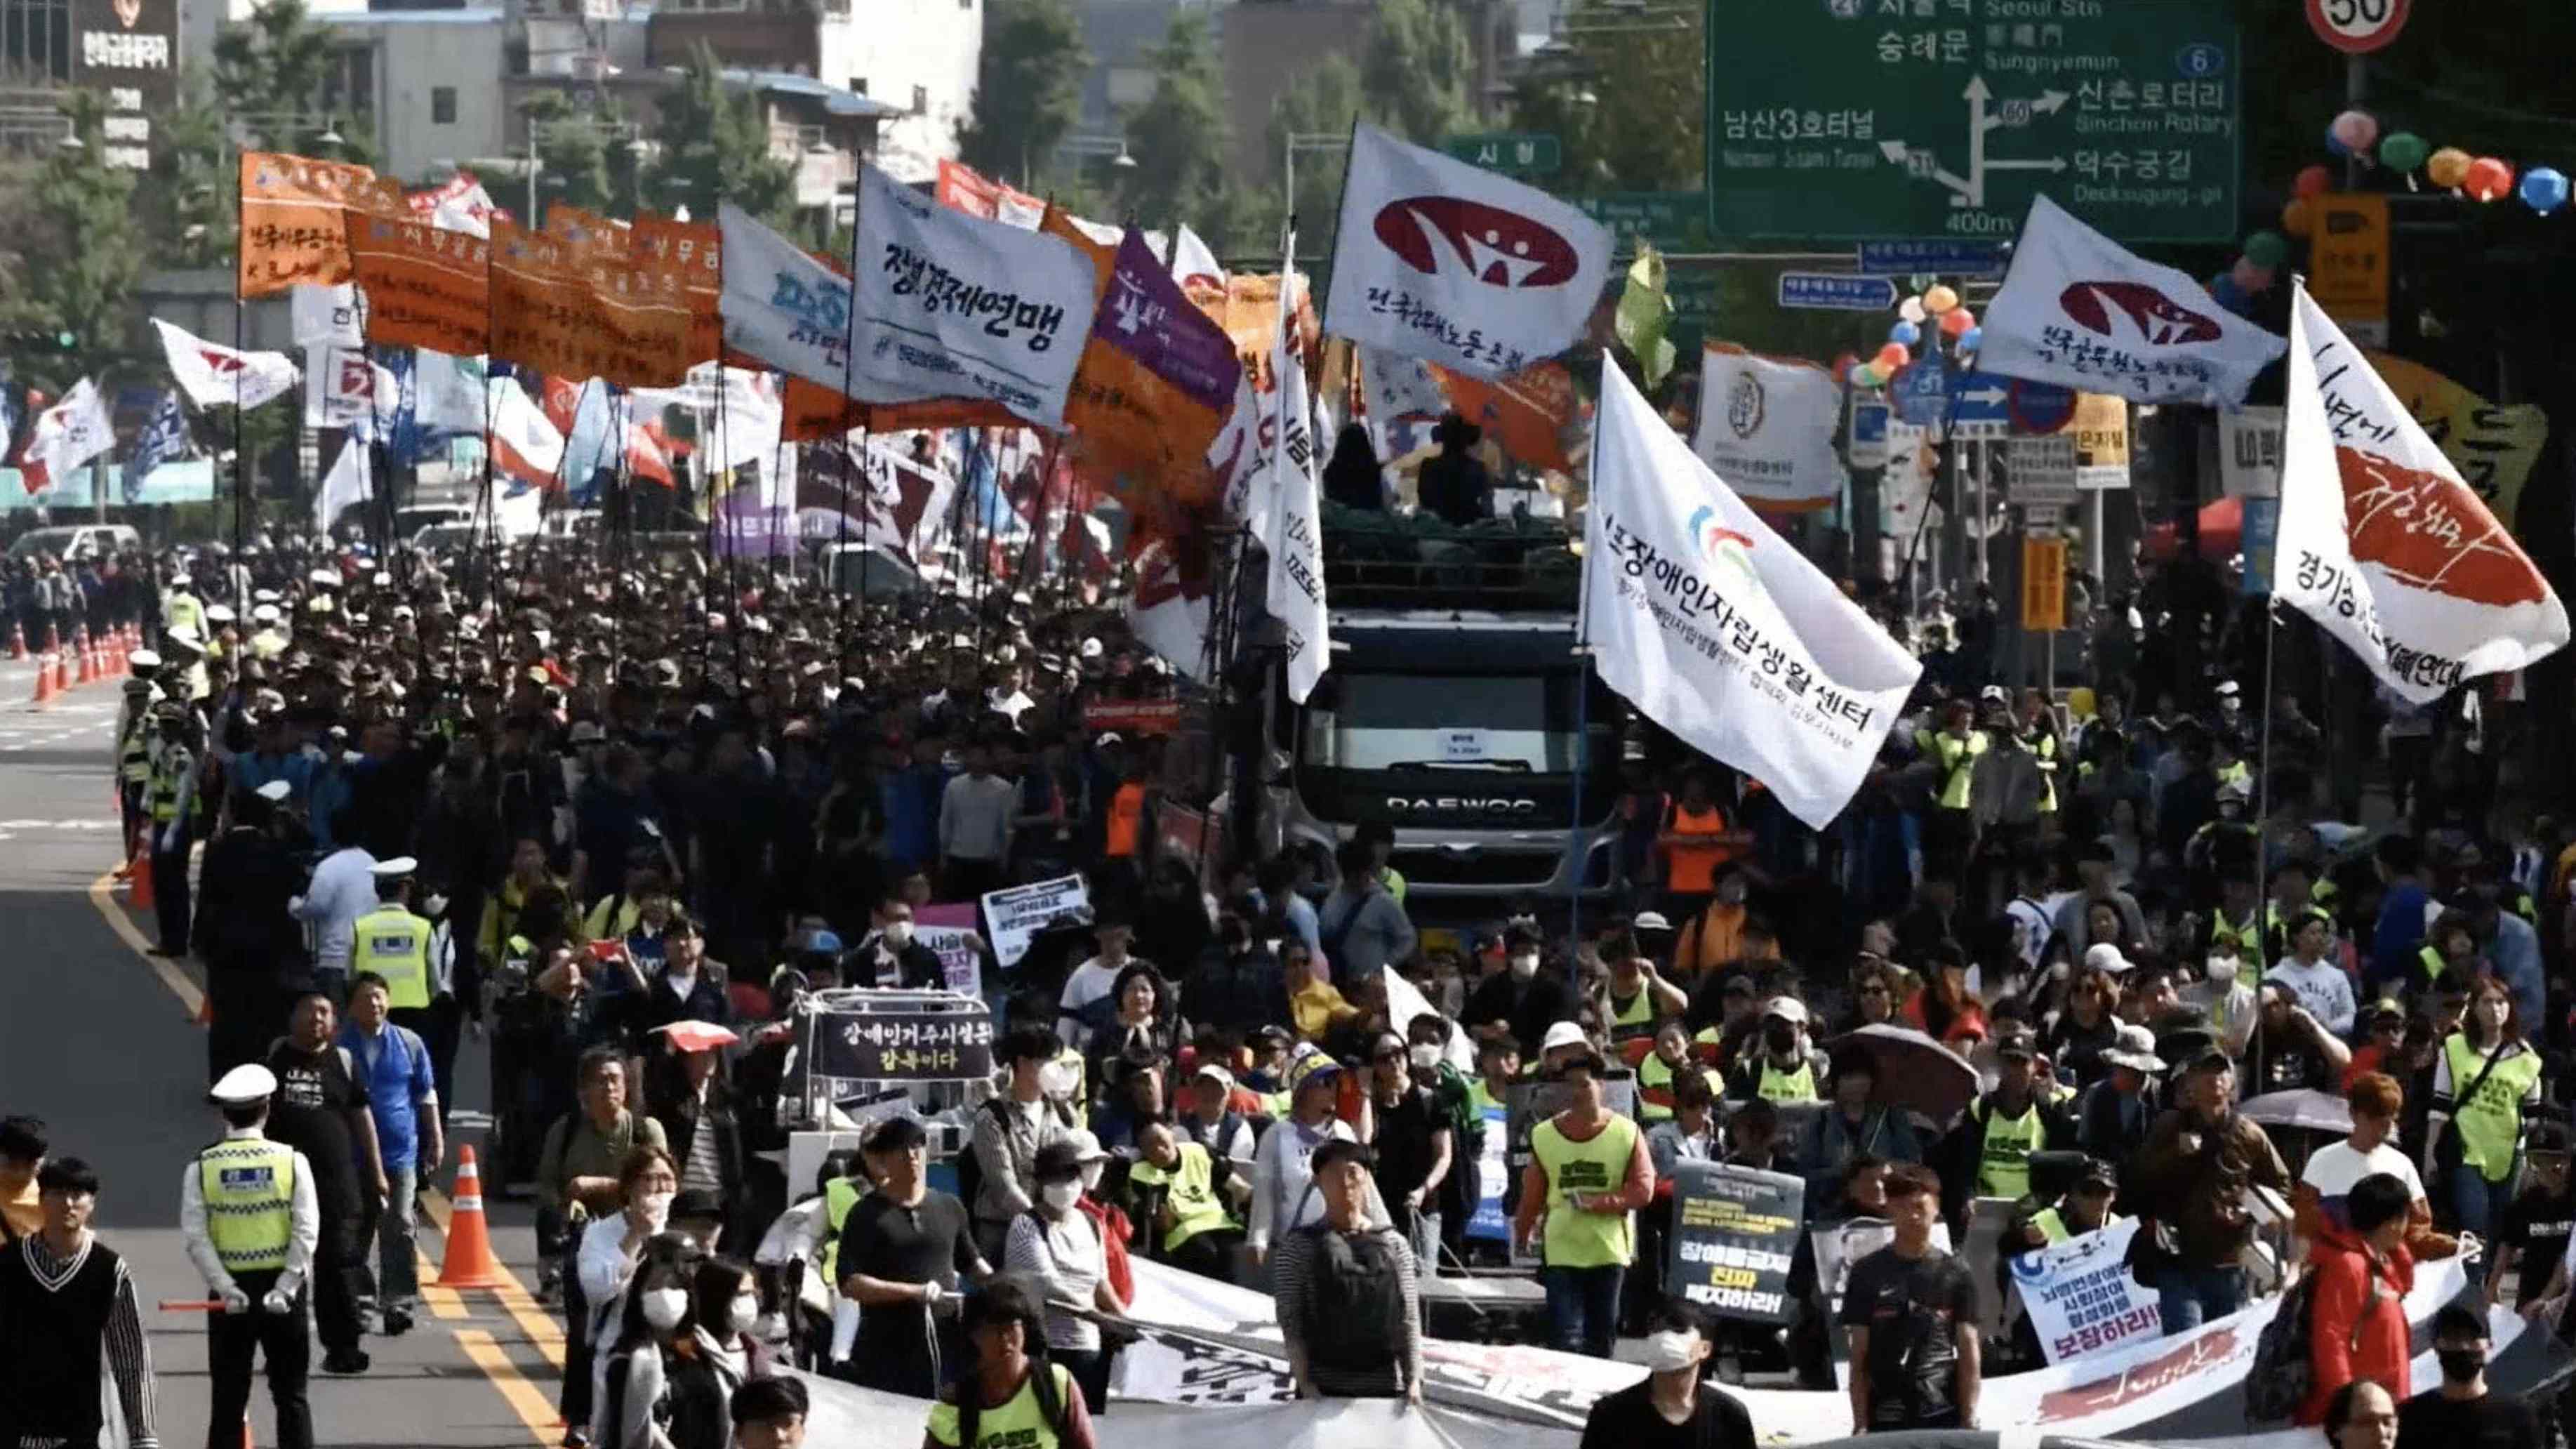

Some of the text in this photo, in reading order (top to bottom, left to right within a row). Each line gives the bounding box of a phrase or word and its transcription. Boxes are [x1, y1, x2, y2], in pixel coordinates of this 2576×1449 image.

[1877, 31, 1969, 62] 숭례문
[1984, 51, 2119, 72] Sungnyemun
[2191, 48, 2207, 71] 6
[2076, 79, 2224, 110] 신촌로터리
[1725, 108, 1874, 140] 남산3호터널
[2076, 112, 2234, 138] Sinchon Rotary
[2074, 149, 2191, 180] 덕수궁길
[1946, 212, 2014, 234] 400m
[1386, 797, 1536, 811] DAEWOO
[879, 1048, 958, 1072] 감옥이다
